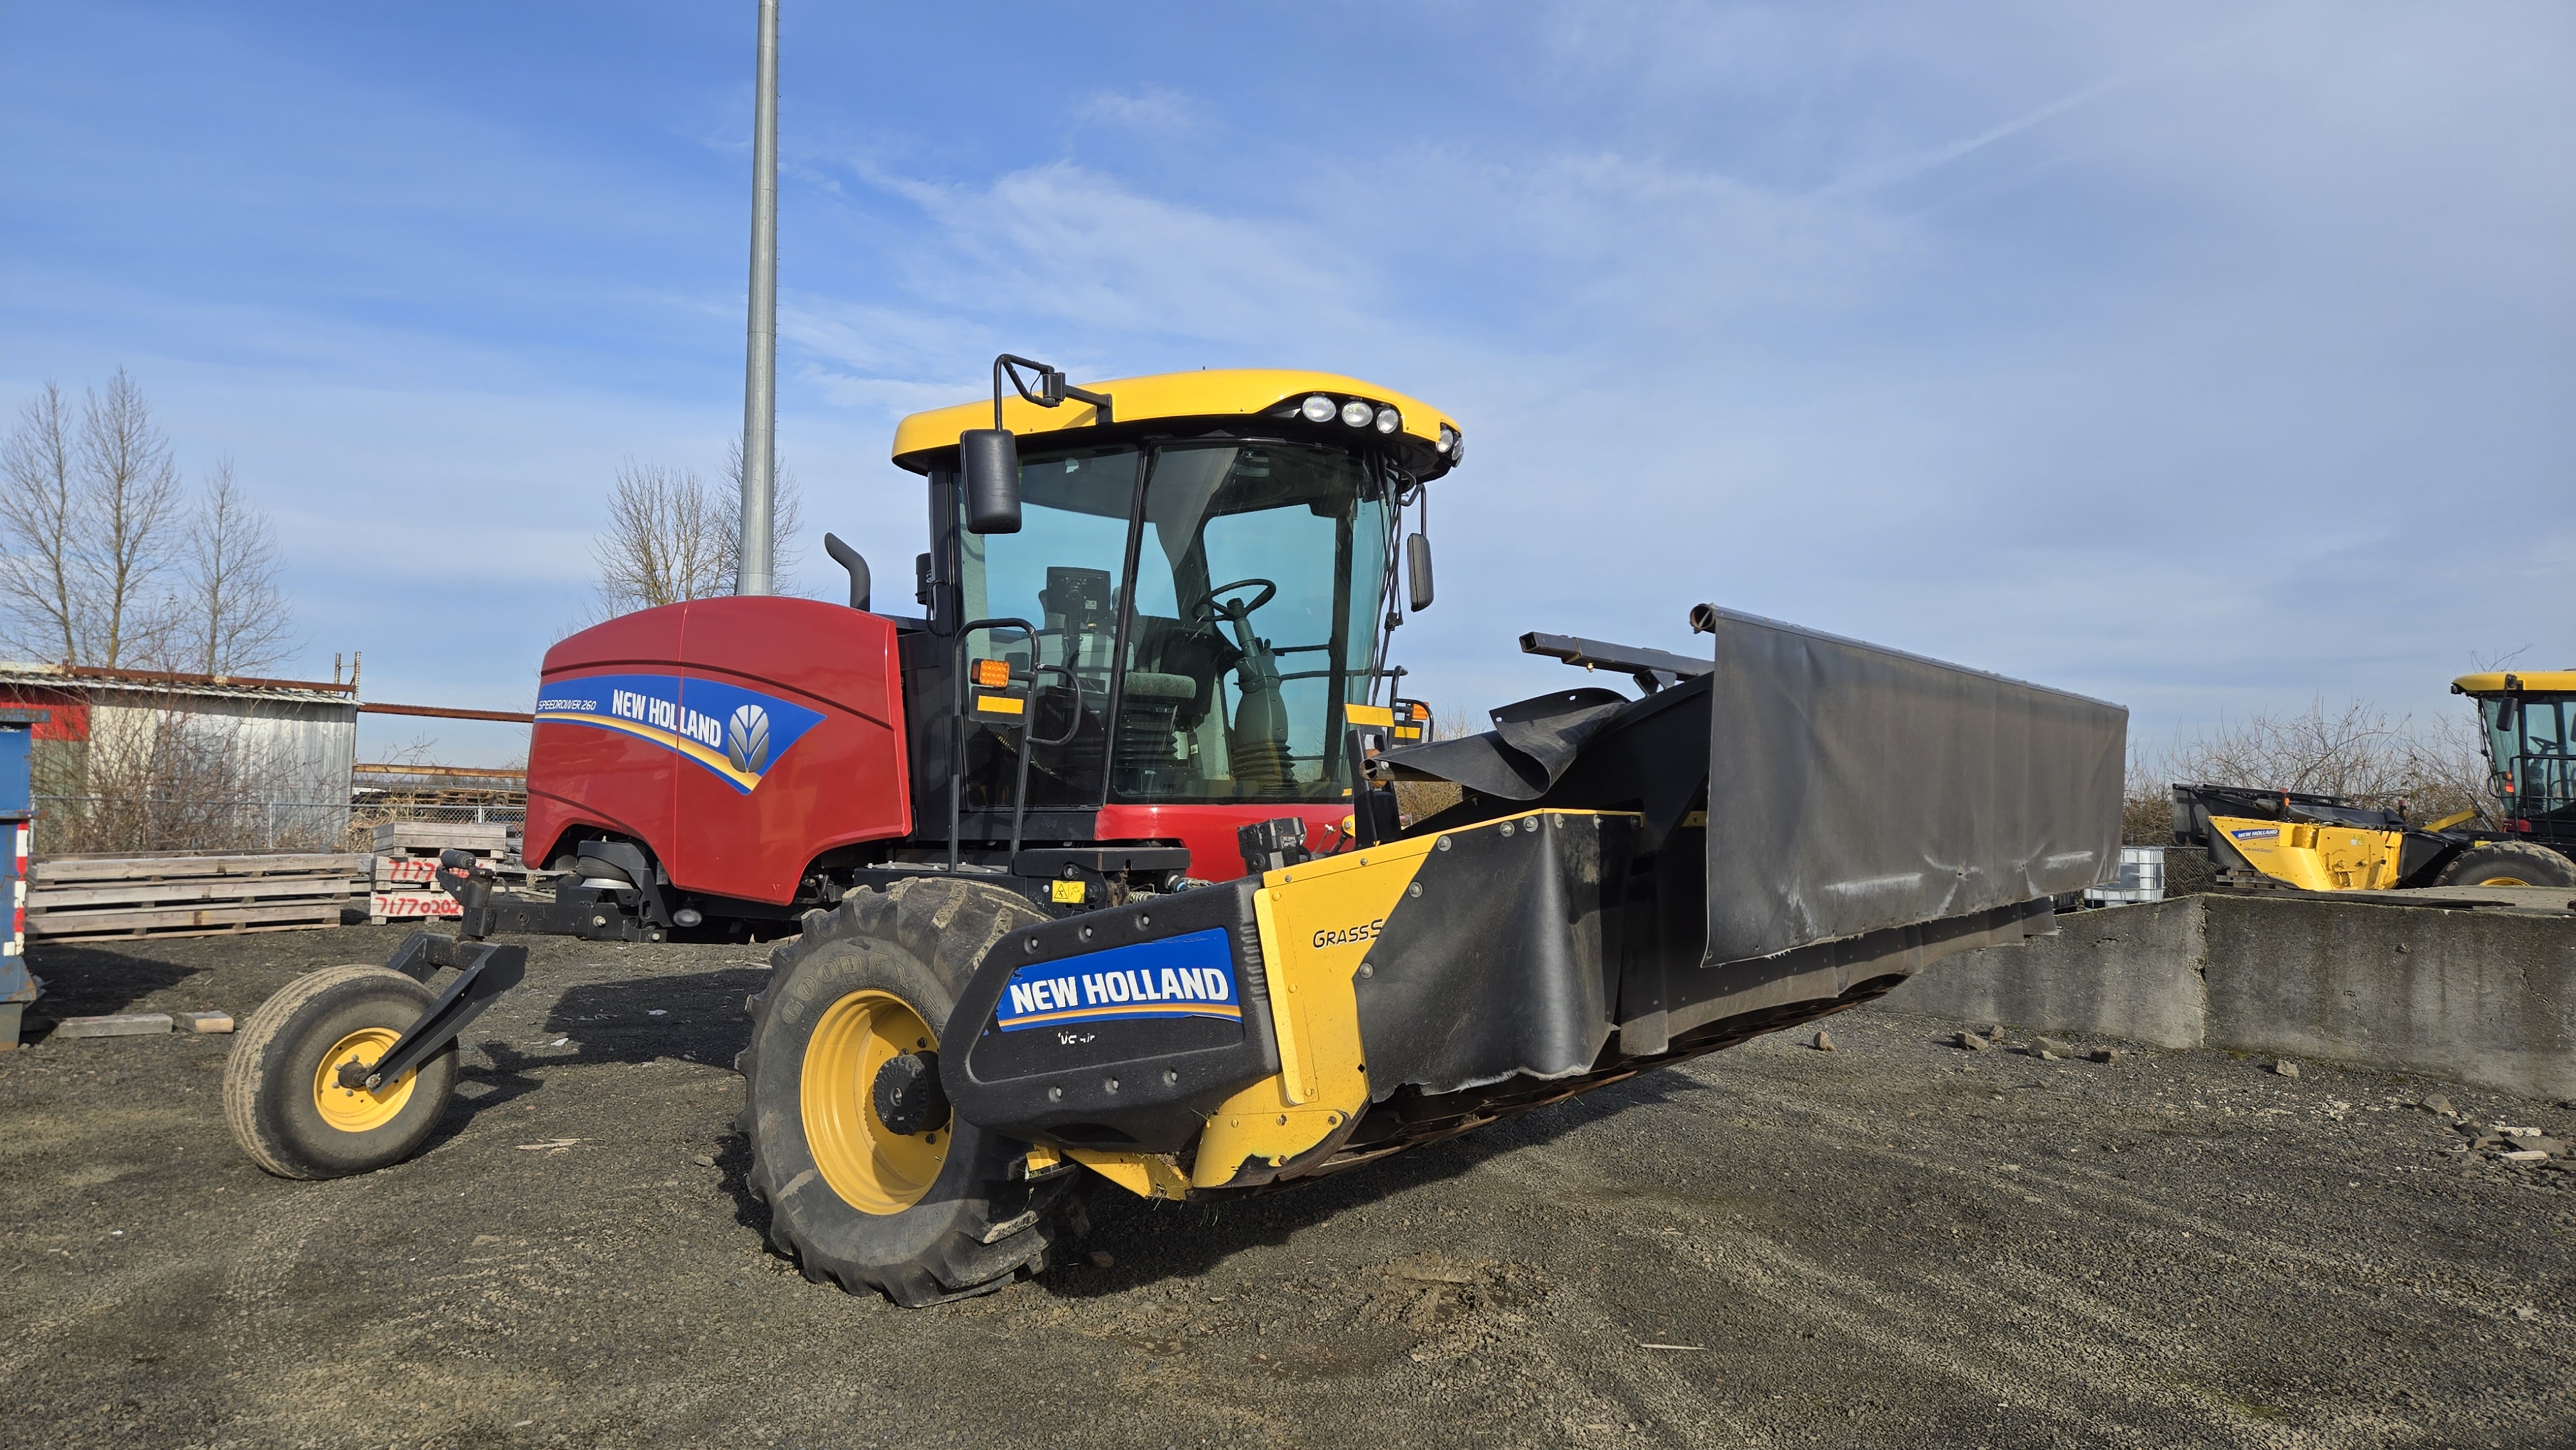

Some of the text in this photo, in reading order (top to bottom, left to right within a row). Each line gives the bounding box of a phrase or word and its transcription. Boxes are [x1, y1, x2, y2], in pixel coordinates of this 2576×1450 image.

[538, 699, 597, 710] SPEEDROWER 260
[612, 689, 722, 748] NEW HOLLAND
[375, 897, 464, 914] 71770202
[1313, 919, 1383, 948] GRASSS
[781, 950, 945, 1034] GOODYE
[1010, 967, 1229, 1015] NEW HOLLAND
